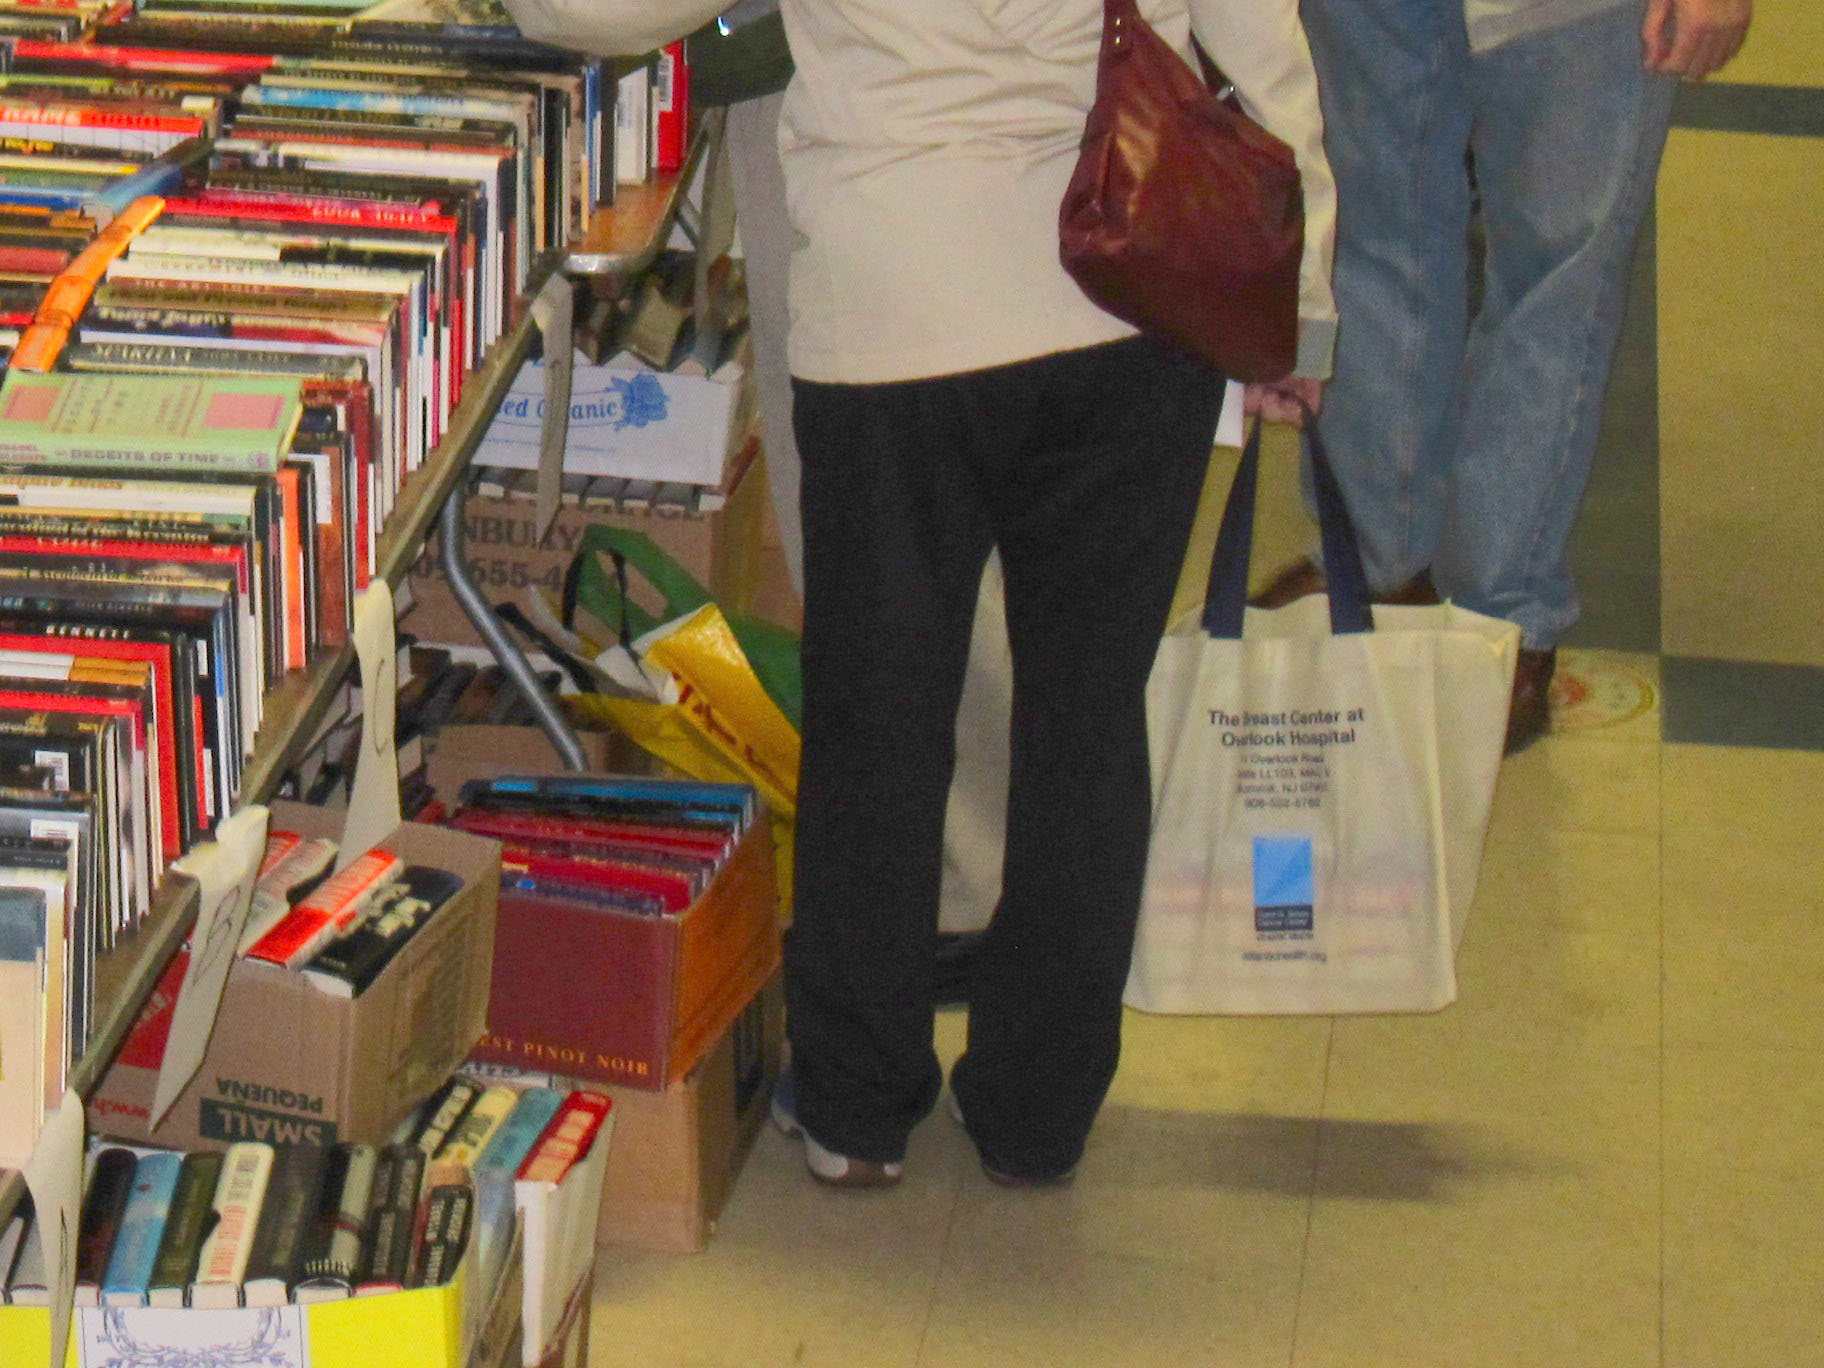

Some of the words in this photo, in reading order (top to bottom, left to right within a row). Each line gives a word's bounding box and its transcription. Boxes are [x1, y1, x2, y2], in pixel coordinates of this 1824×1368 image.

[537, 399, 618, 420] Oanic
[179, 452, 220, 464] TIME
[1346, 707, 1364, 721] at
[1290, 728, 1356, 747] Hospital
[523, 1042, 587, 1064] PINOT
[596, 1053, 650, 1076] NOIR
[218, 1107, 324, 1147] SMALL
